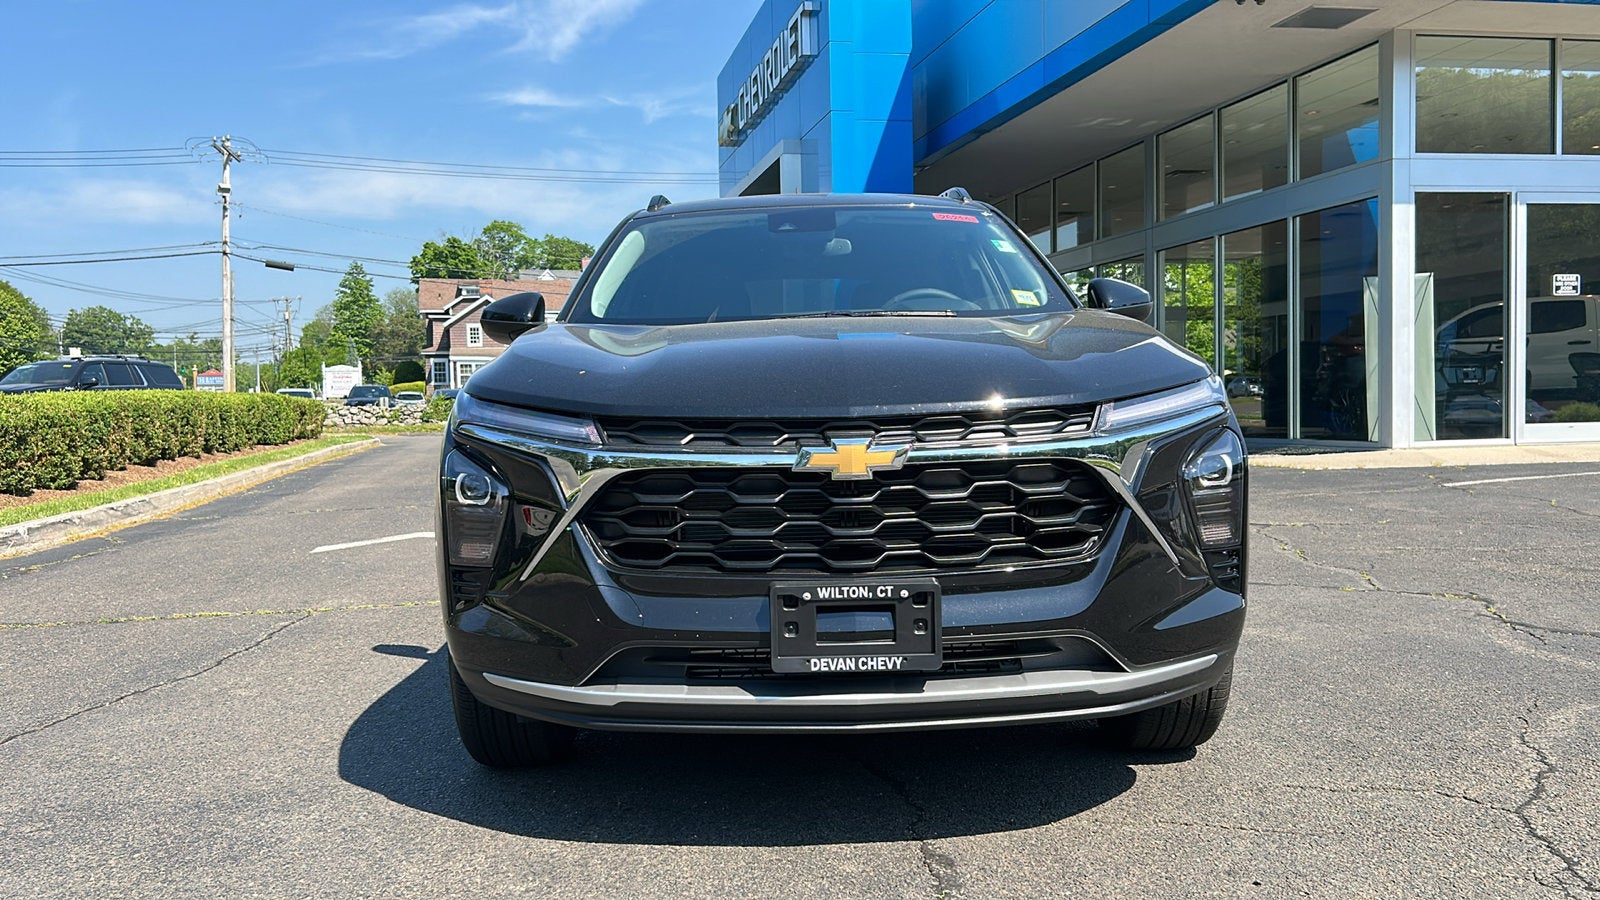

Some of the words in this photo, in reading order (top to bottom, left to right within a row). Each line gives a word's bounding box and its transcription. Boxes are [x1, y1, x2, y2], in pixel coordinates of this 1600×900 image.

[738, 1, 814, 131] CHEVROLET
[817, 586, 873, 599] WILTON,
[876, 585, 894, 598] CT
[810, 657, 856, 671] DEVAN
[858, 656, 903, 670] CHEVY
